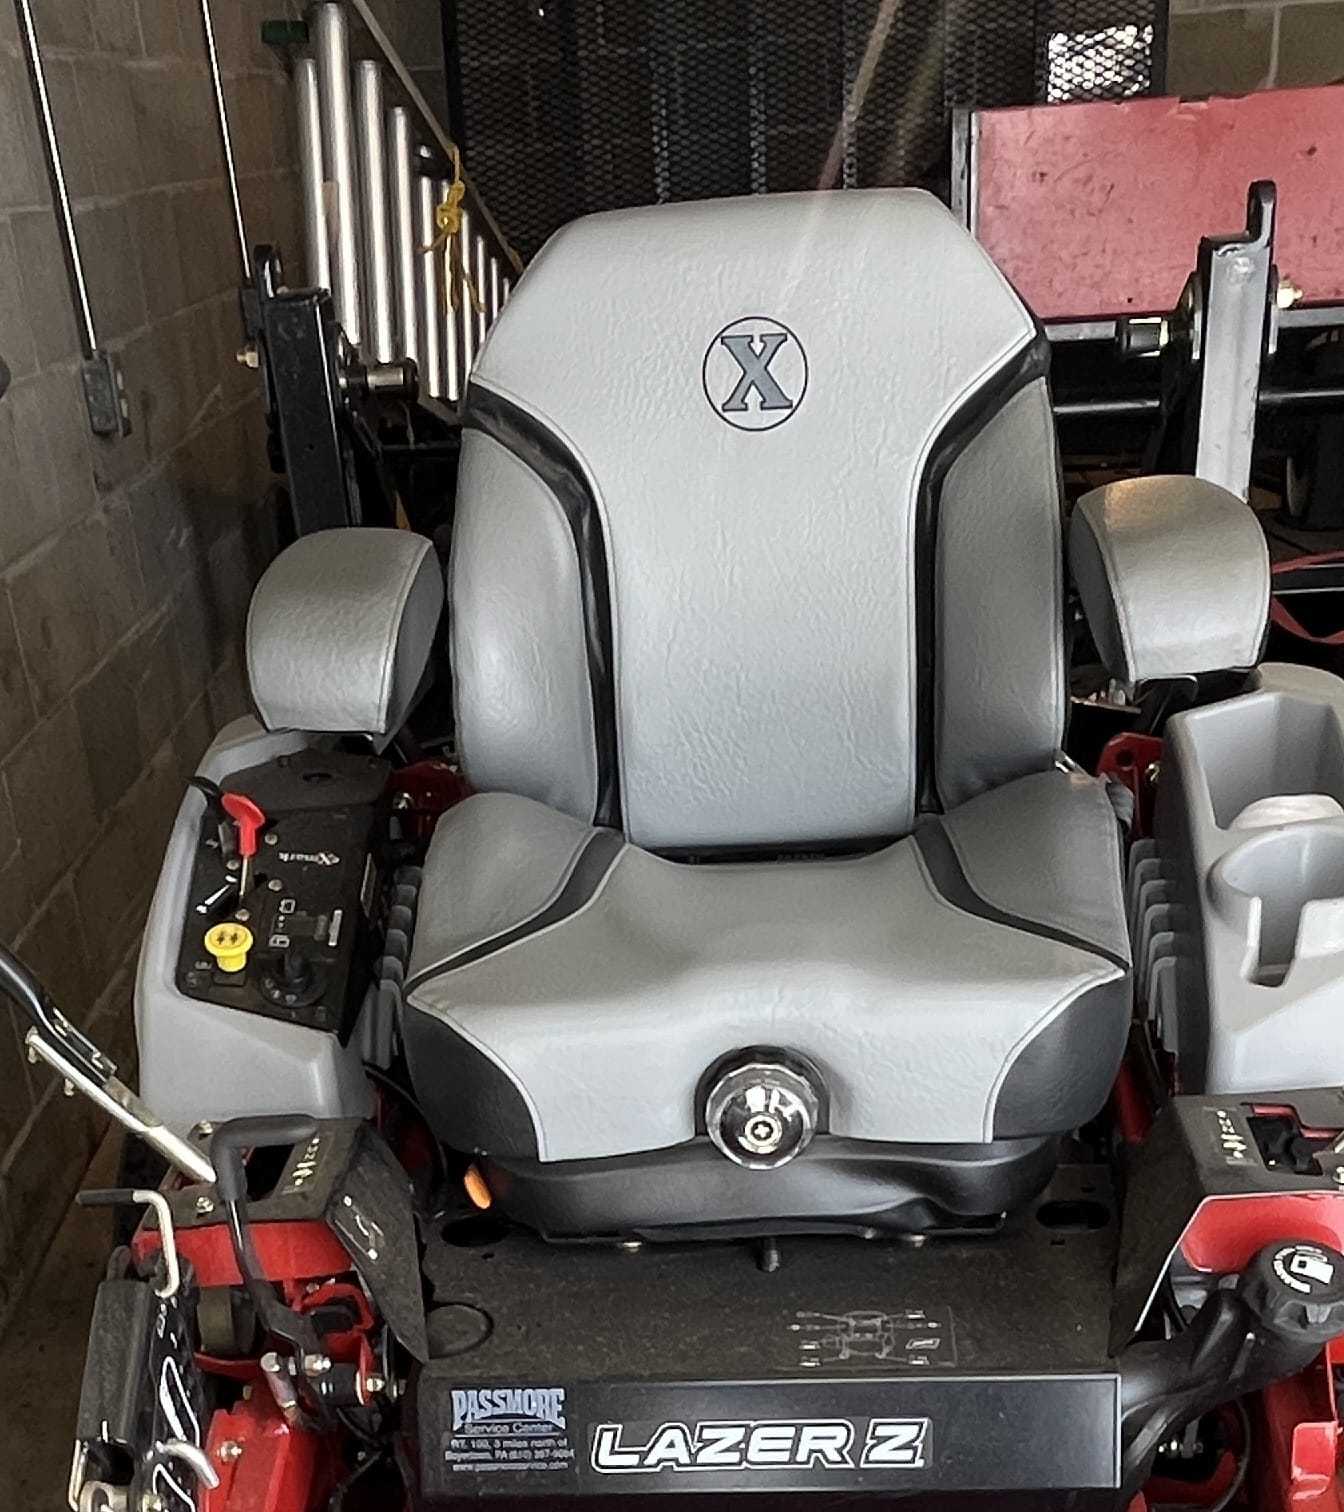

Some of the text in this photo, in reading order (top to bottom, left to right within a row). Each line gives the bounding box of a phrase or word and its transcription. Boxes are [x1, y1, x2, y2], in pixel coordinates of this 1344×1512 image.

[720, 332, 794, 412] X
[450, 1388, 566, 1431] PASSMORE
[464, 1423, 553, 1435] Service Center
[592, 1418, 928, 1472] LAZER Z
